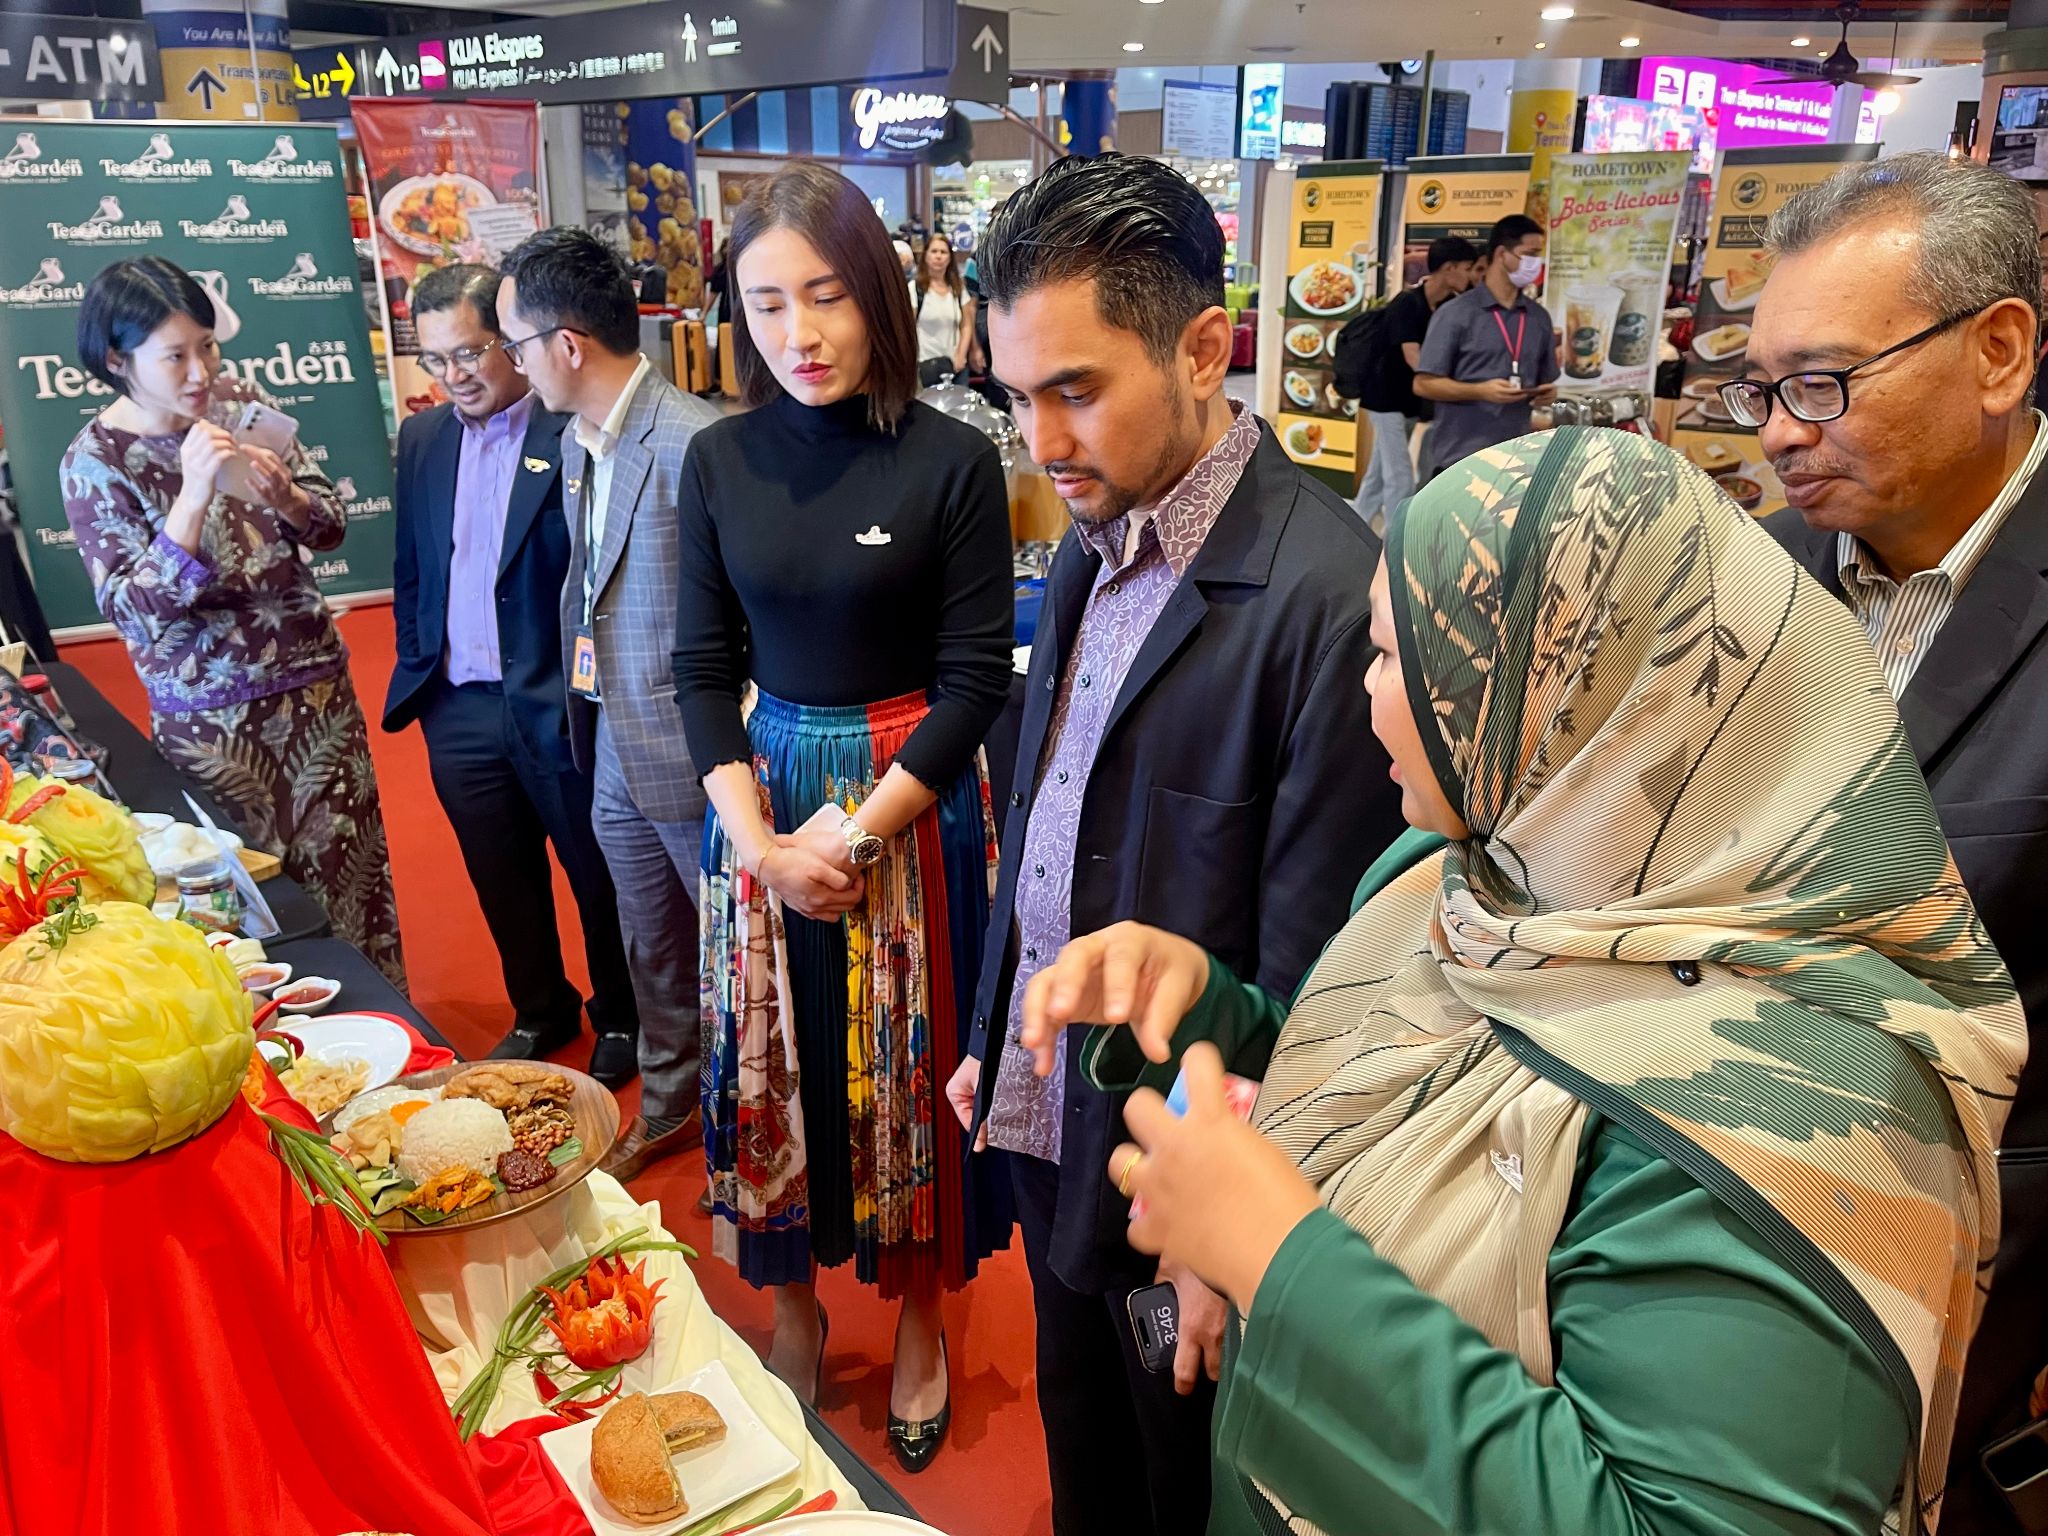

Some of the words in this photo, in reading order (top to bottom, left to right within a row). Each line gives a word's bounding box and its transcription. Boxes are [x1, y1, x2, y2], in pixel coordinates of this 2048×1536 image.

[183, 27, 208, 40] You
[211, 27, 233, 41] Are
[485, 32, 544, 67] Ekspres
[26, 35, 147, 86] ATM
[402, 63, 421, 91] L2
[478, 67, 518, 92] Express
[14, 159, 84, 177] Garden
[99, 159, 132, 176] Tea
[148, 159, 213, 176] Garden
[227, 159, 260, 177] Tea
[274, 160, 335, 177] Garden
[1572, 160, 1668, 177] HOMETOWN
[1551, 190, 1681, 229] Boba-licious
[47, 222, 82, 240] Tea
[97, 221, 164, 239] Garden
[178, 220, 211, 238] Tea
[226, 220, 289, 237] Garden
[39, 281, 86, 301] Gard
[247, 277, 278, 294] Tea
[295, 275, 354, 293] Garden
[220, 341, 356, 388] arden
[347, 497, 392, 515] arden
[36, 527, 72, 545] Tea
[311, 560, 350, 577] rden
[1157, 1306, 1178, 1345] 3:46
